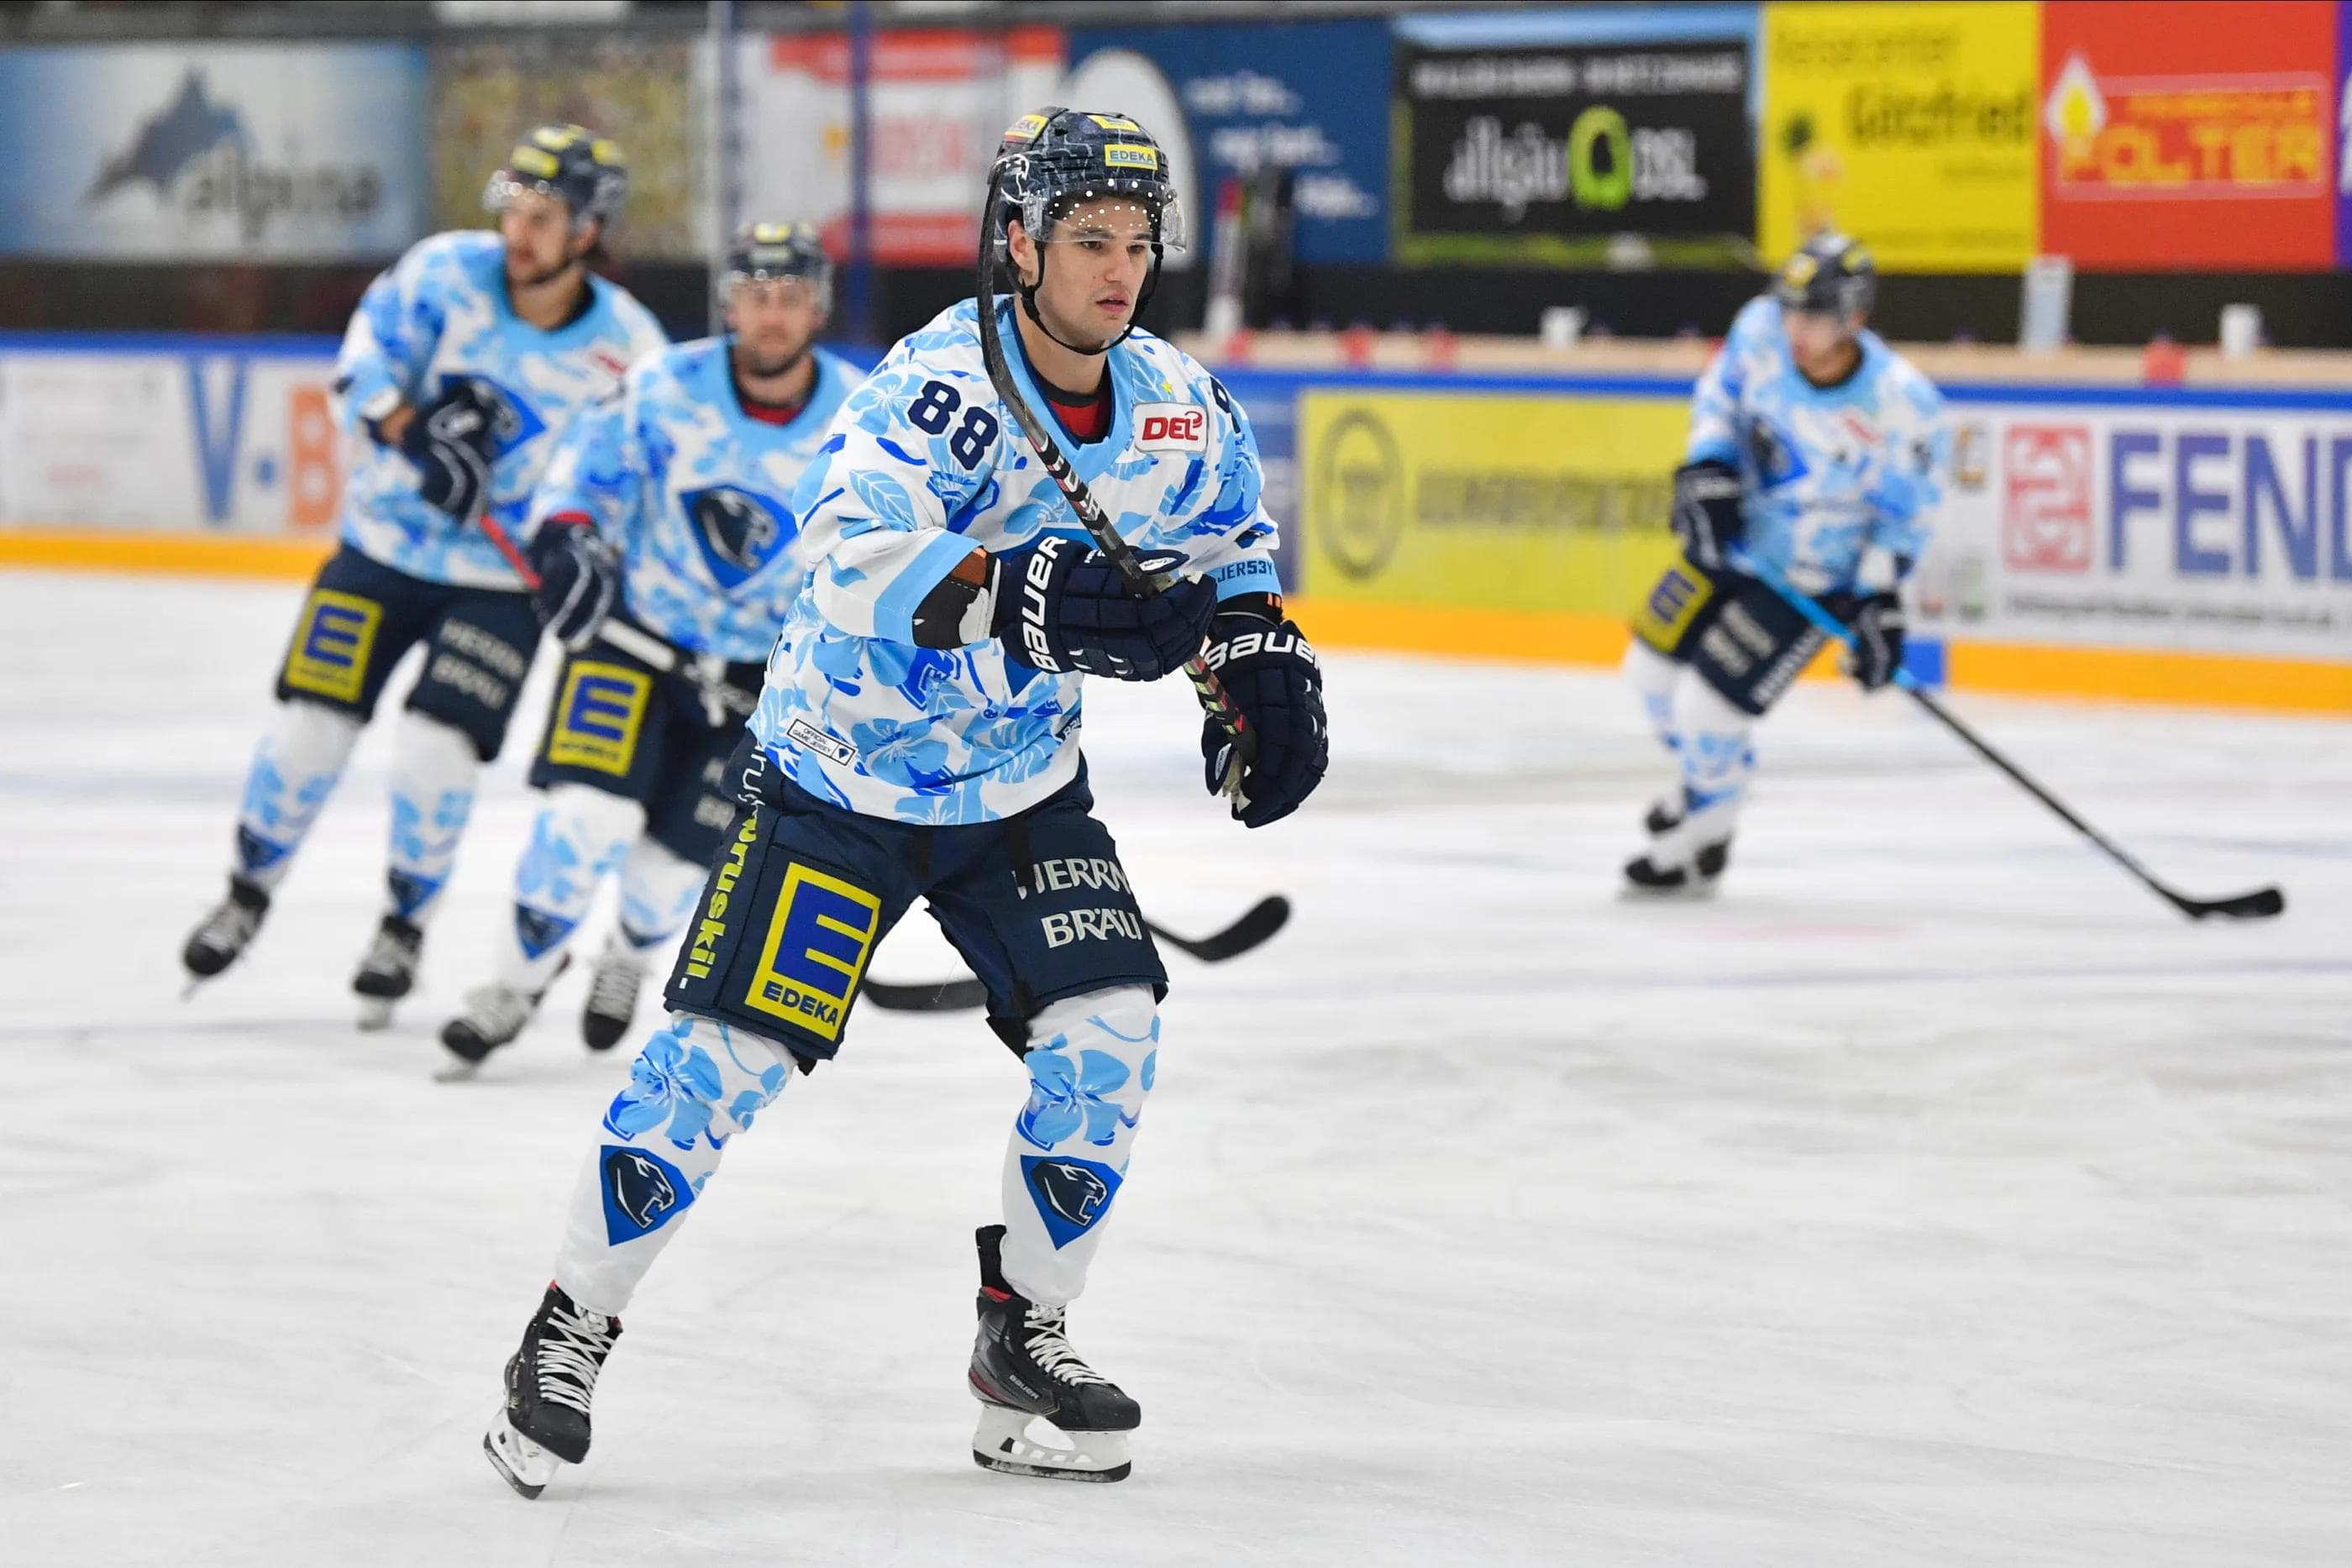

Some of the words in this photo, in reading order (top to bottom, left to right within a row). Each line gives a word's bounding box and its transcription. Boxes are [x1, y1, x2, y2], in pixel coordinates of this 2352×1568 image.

[1110, 149, 1155, 164] EDEKA
[907, 380, 998, 470] 88
[1021, 536, 1069, 672] BAUER
[792, 729, 809, 742] GAME
[811, 741, 832, 753] JERSEY
[803, 727, 827, 745] OFFICIAL
[1041, 908, 1142, 949] BRÄU
[762, 980, 839, 1026] EDEKA
[1009, 1374, 1040, 1400] BAUER
